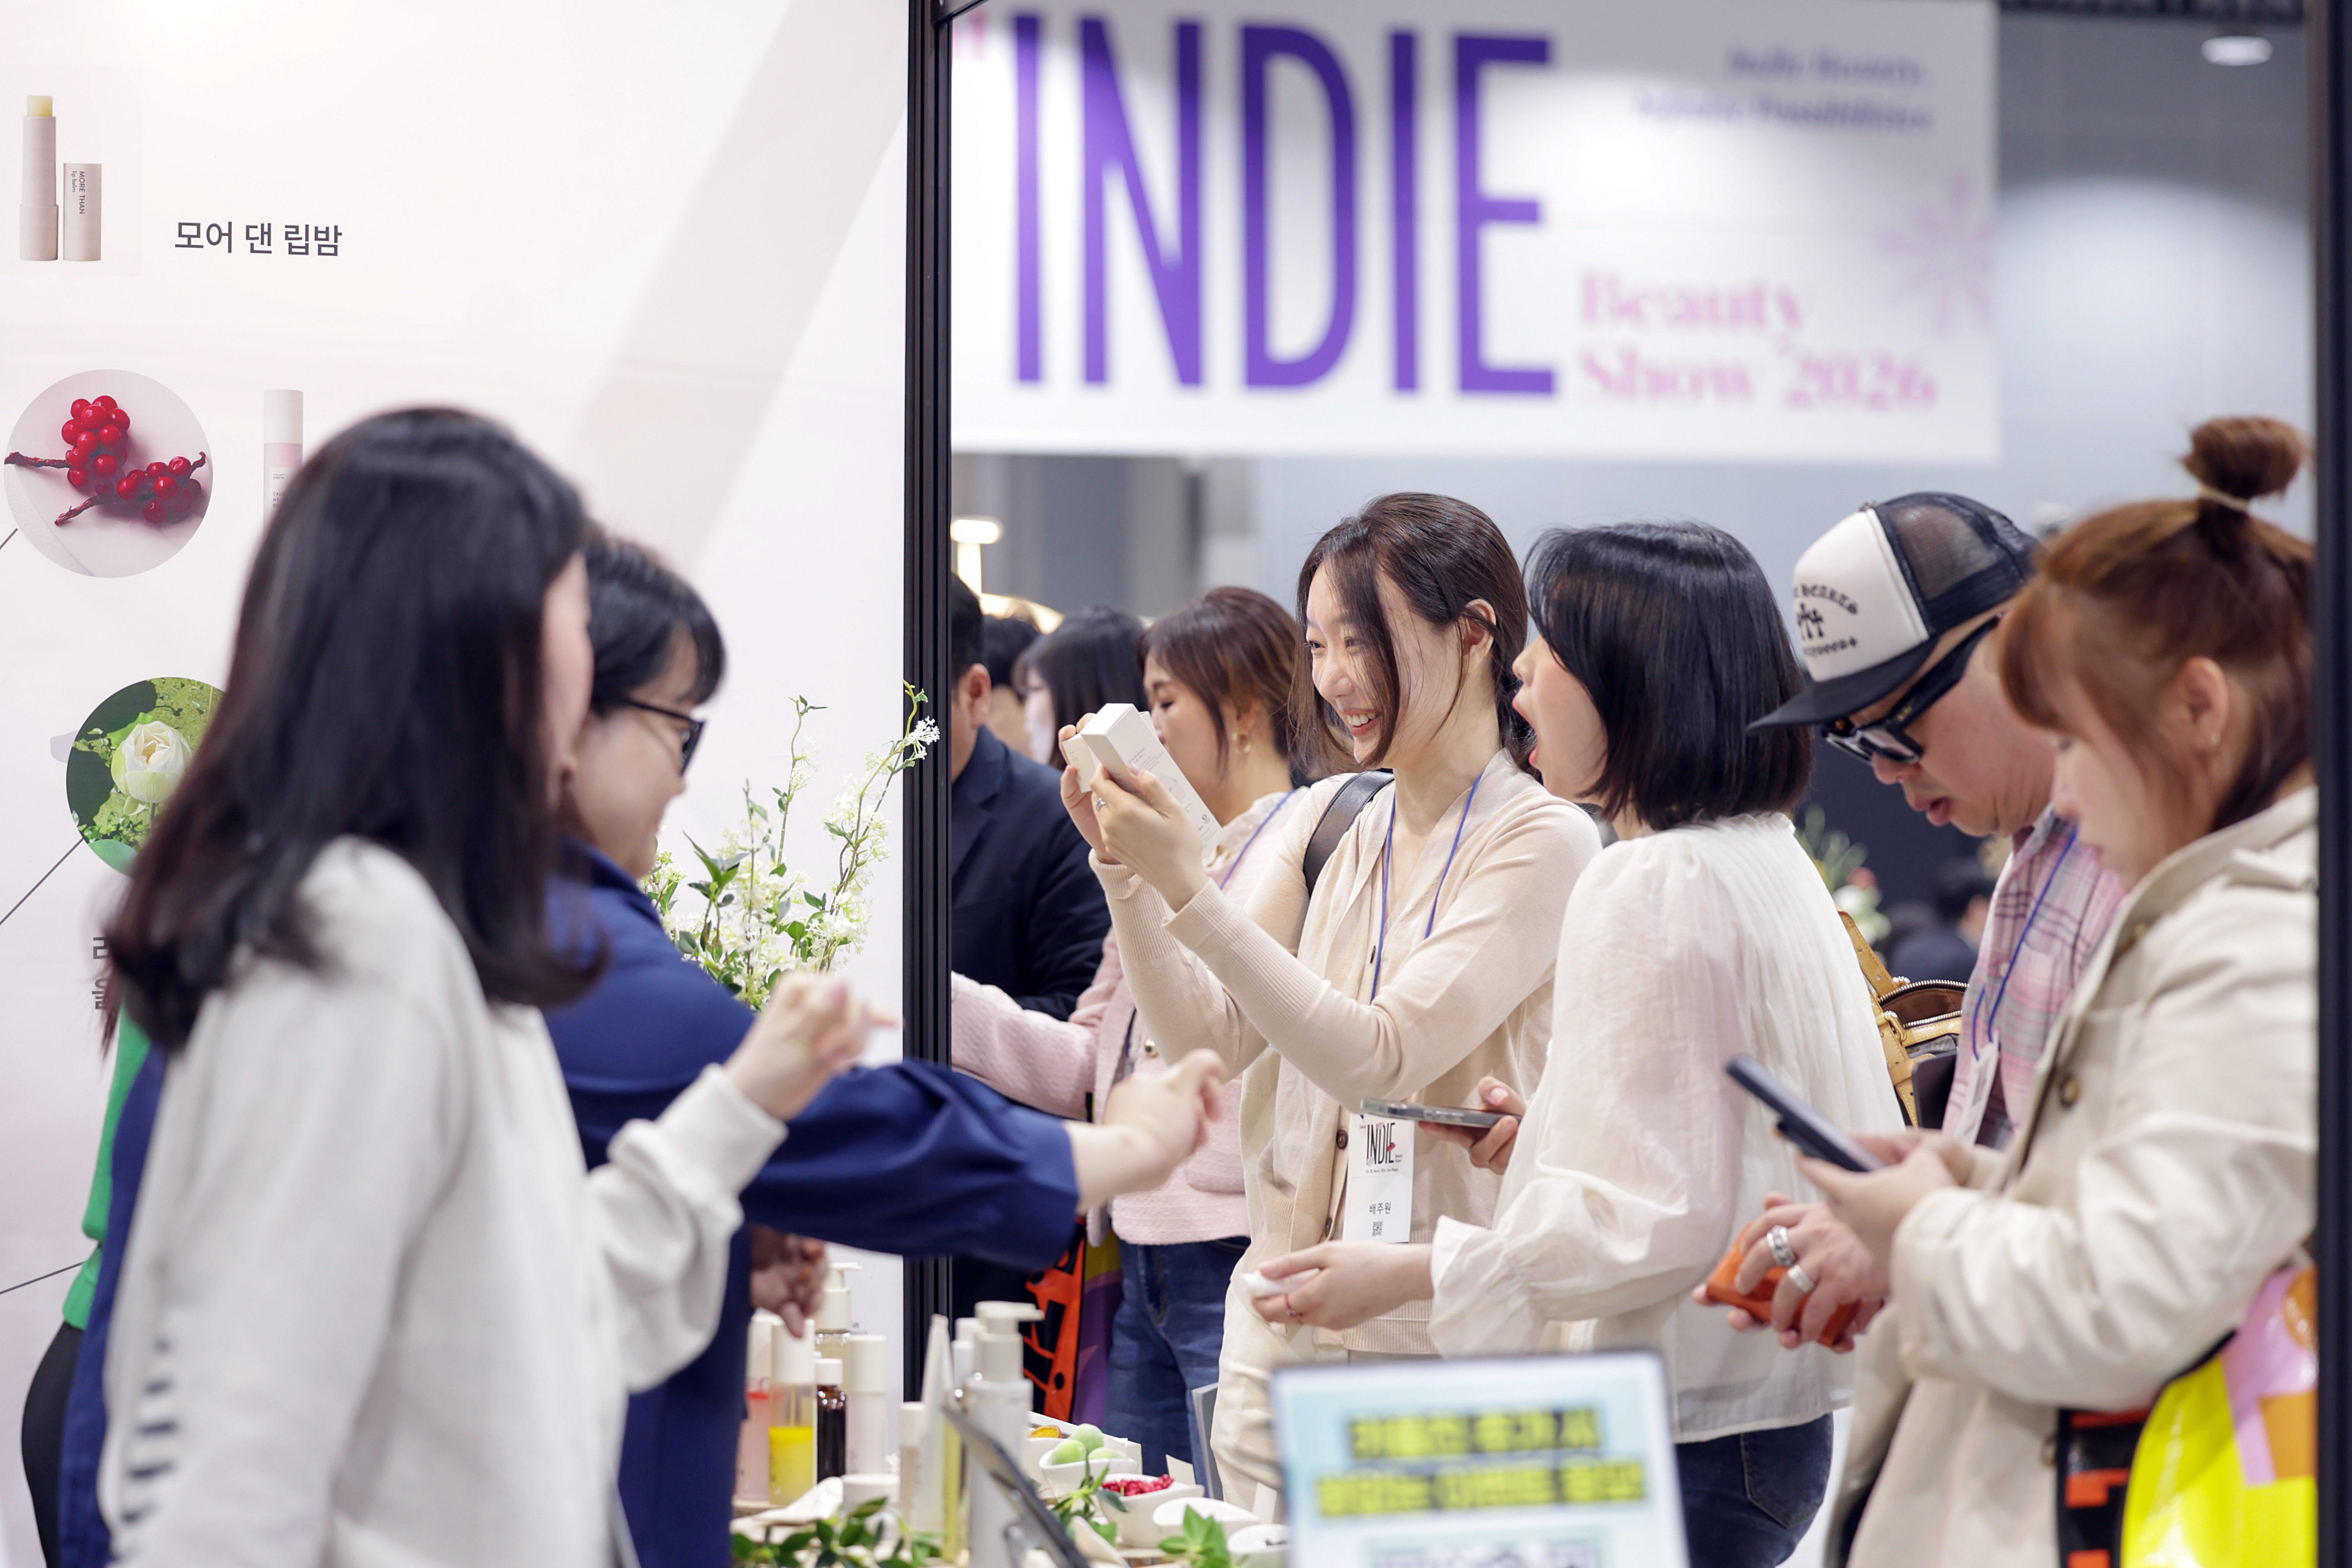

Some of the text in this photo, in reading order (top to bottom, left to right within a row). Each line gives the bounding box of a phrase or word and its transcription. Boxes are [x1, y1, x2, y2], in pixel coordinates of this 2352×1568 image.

[1012, 13, 1559, 397] INDIE
[175, 221, 342, 256] 모어 댄 립밤
[1579, 265, 1803, 357] Beauty
[1578, 344, 1754, 404] Show
[1366, 1122, 1396, 1165] INDIE
[1369, 1202, 1391, 1214] 배주원
